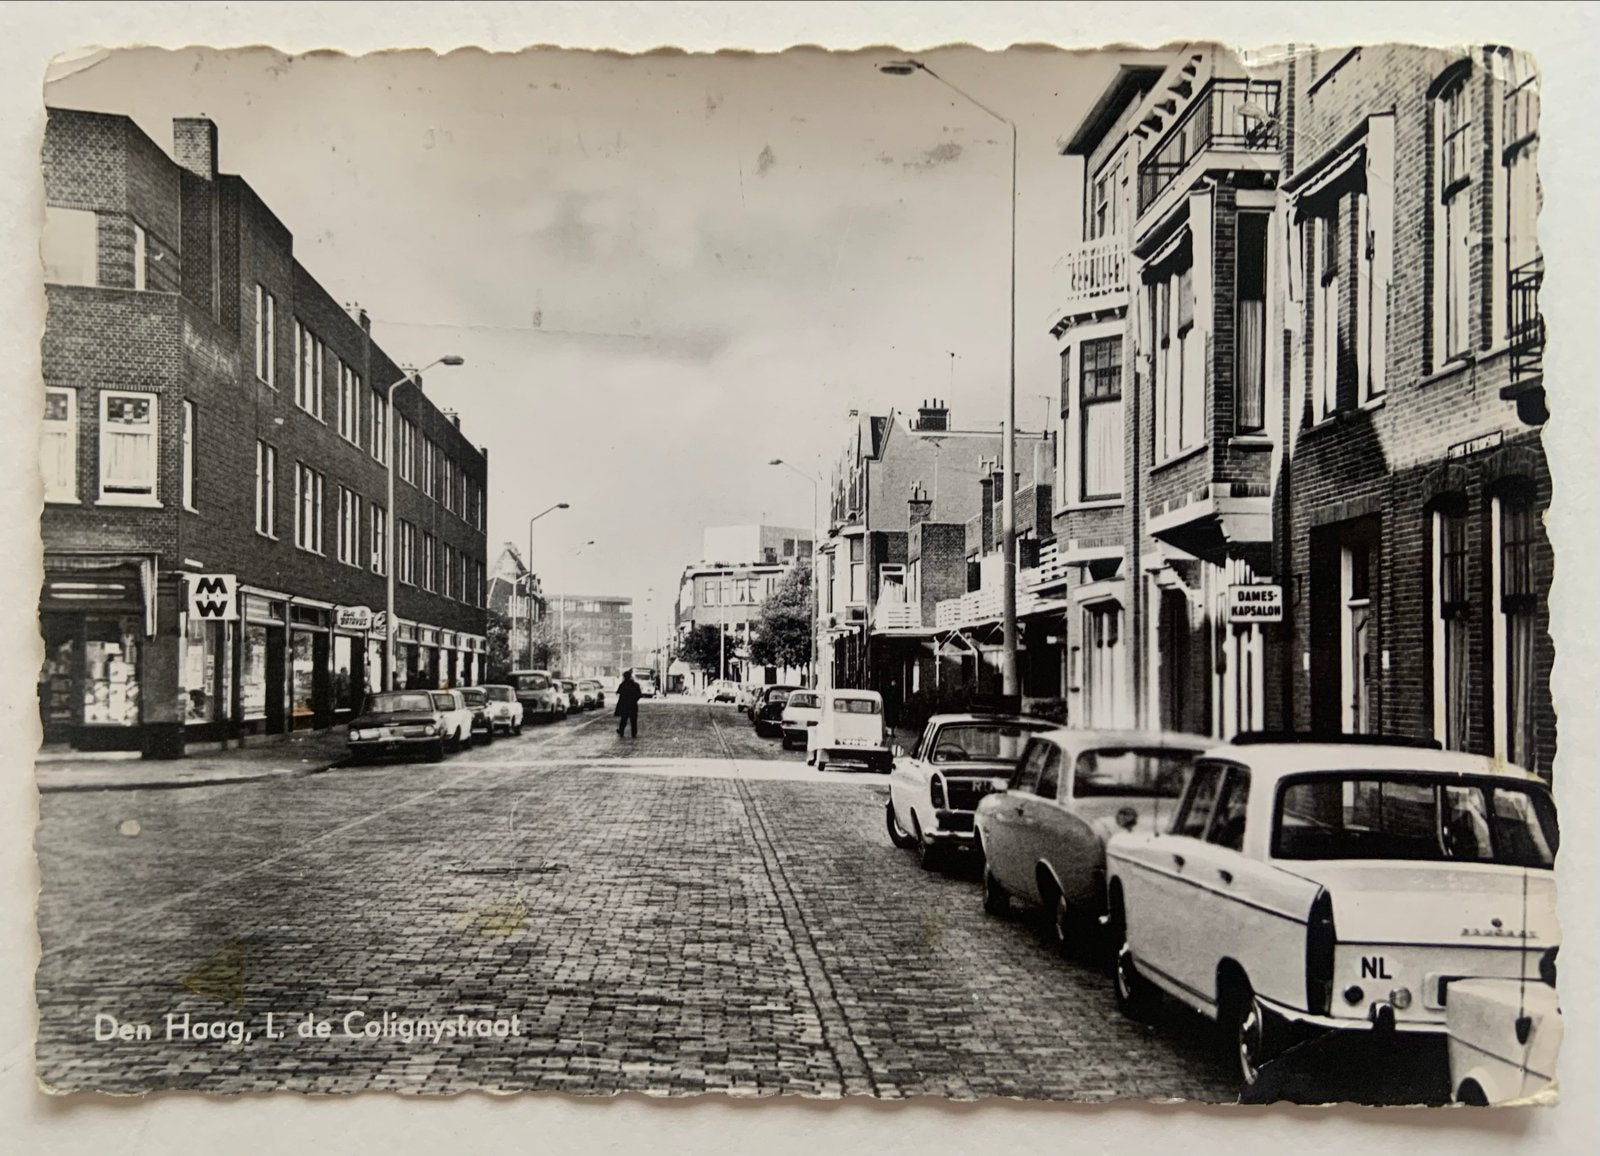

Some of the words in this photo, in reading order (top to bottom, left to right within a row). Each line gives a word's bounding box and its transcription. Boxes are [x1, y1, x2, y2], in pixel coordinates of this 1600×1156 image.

[196, 577, 228, 594] M
[1238, 590, 1278, 602] DAMES-
[196, 600, 228, 617] W
[1231, 605, 1281, 617] KAPSALON
[1361, 956, 1393, 979] NL
